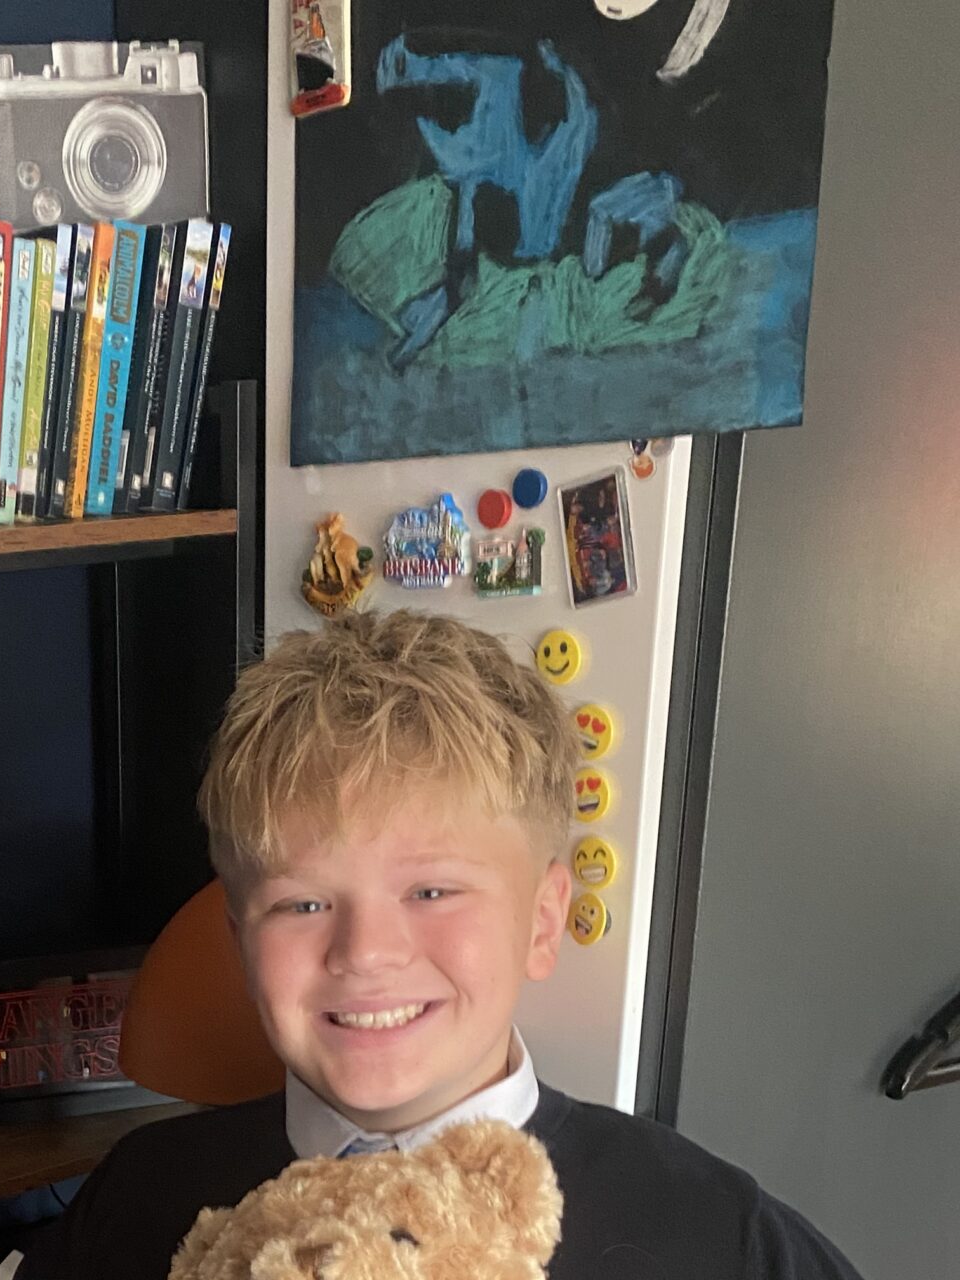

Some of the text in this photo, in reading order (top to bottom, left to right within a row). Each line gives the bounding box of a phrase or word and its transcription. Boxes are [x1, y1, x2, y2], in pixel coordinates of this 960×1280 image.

[113, 235, 137, 318] ANIMALCOLM
[96, 359, 120, 485] DAVID BADDIEL
